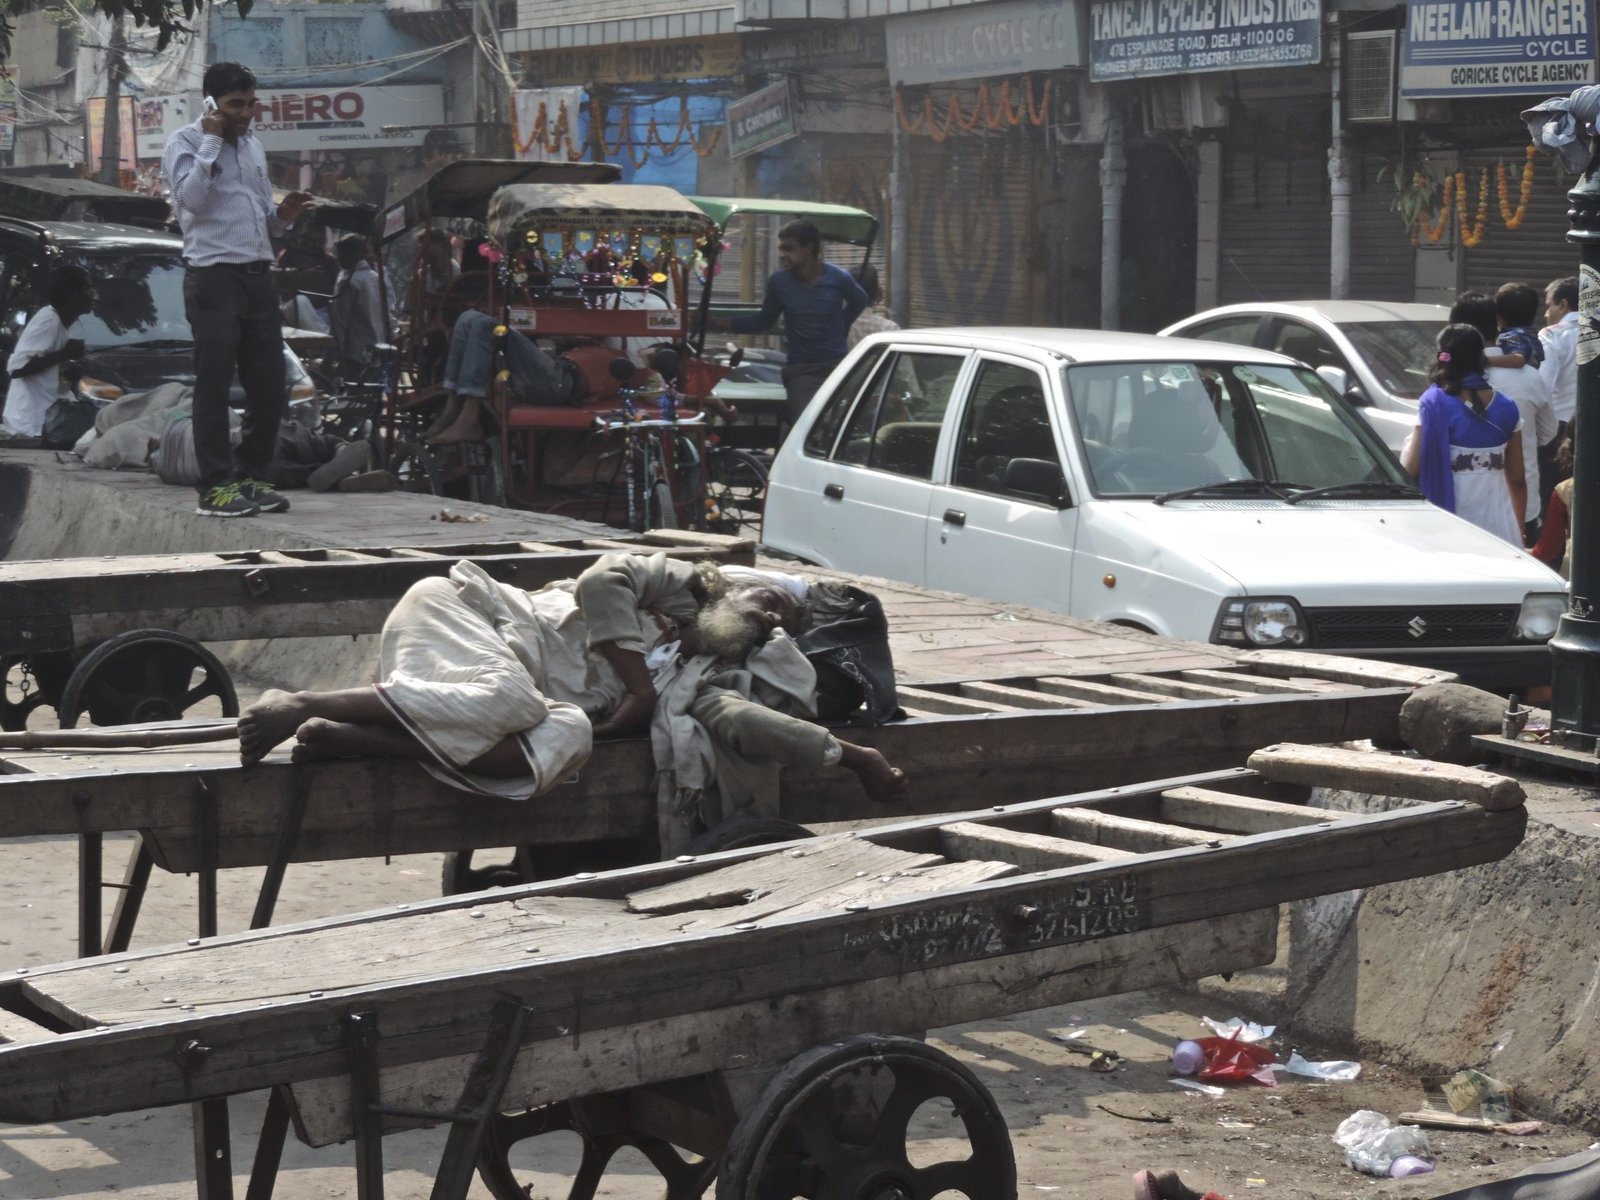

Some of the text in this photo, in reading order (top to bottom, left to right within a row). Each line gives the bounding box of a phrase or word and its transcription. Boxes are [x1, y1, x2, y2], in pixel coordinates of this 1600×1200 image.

[1091, 0, 1154, 41] TANEJA
[1157, 0, 1216, 34] CYCLE
[971, 18, 1032, 59] CYCLE
[1126, 38, 1175, 56] ESPLANADE
[1525, 39, 1588, 57] CYCLE
[1451, 63, 1589, 85] GORICKE CYCLE AGENCY
[254, 91, 365, 122] HERO
[255, 122, 296, 132] CYCLES
[319, 133, 373, 142] COMMERCIAL
